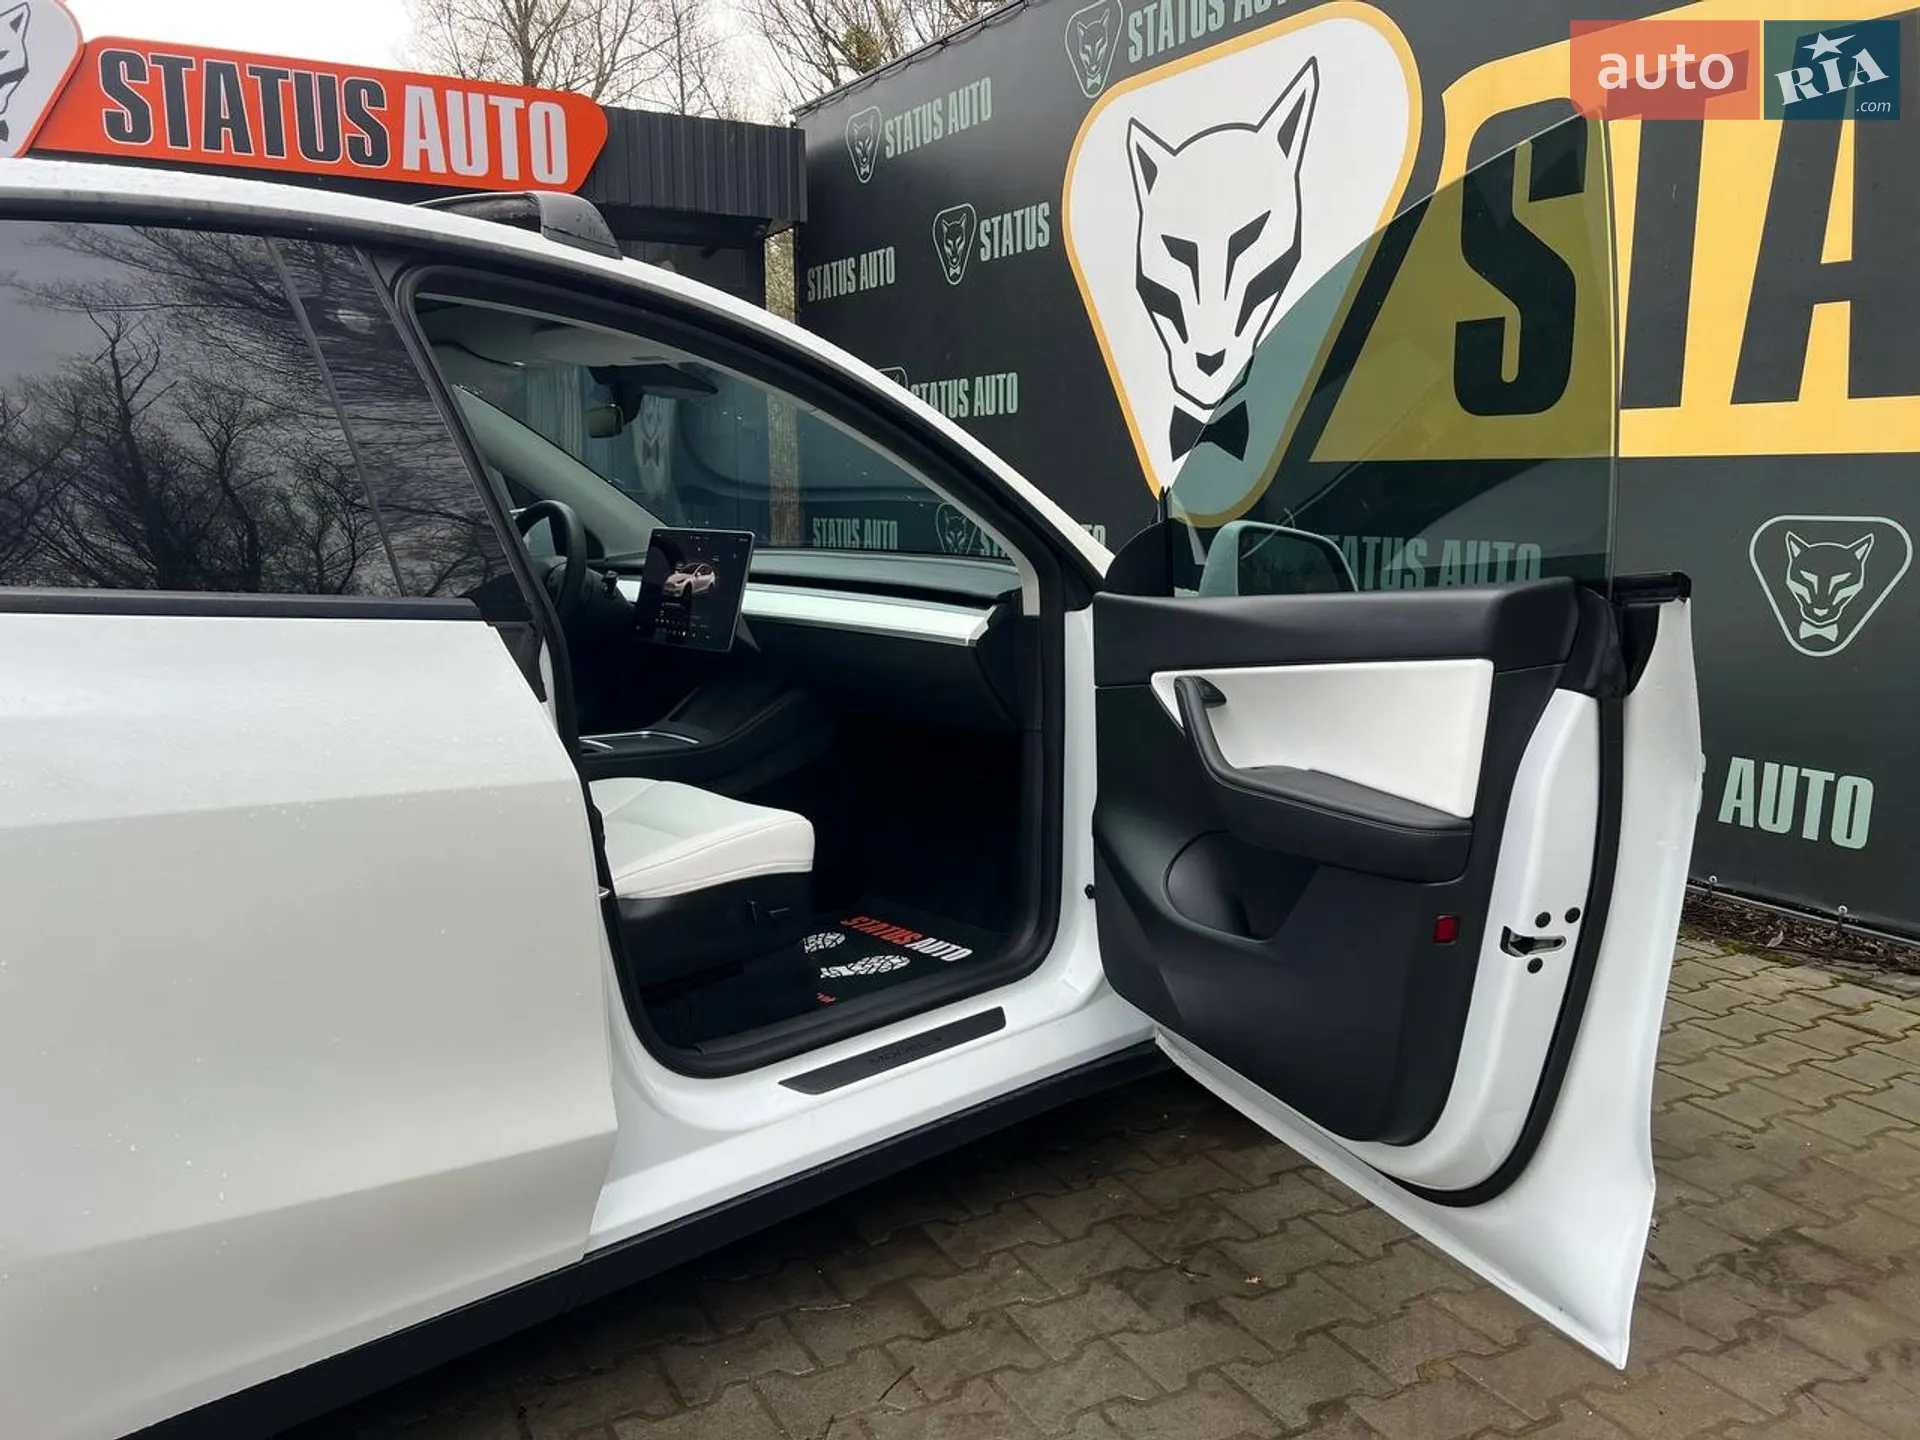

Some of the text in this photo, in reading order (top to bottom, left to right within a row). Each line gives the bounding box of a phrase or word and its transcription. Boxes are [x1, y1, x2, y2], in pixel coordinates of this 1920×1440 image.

[98, 48, 569, 184] STATUS AUTO
[884, 76, 992, 159] STATUS AUTO
[979, 202, 1051, 262] STATUS
[806, 246, 896, 302] STATUS AUTO
[973, 371, 1019, 417] AUTO
[812, 517, 899, 550] STATUS AUTO
[1438, 539, 1543, 588] AUTO
[1717, 756, 1875, 850] AUTO
[840, 916, 974, 962] STATUS AUTO
